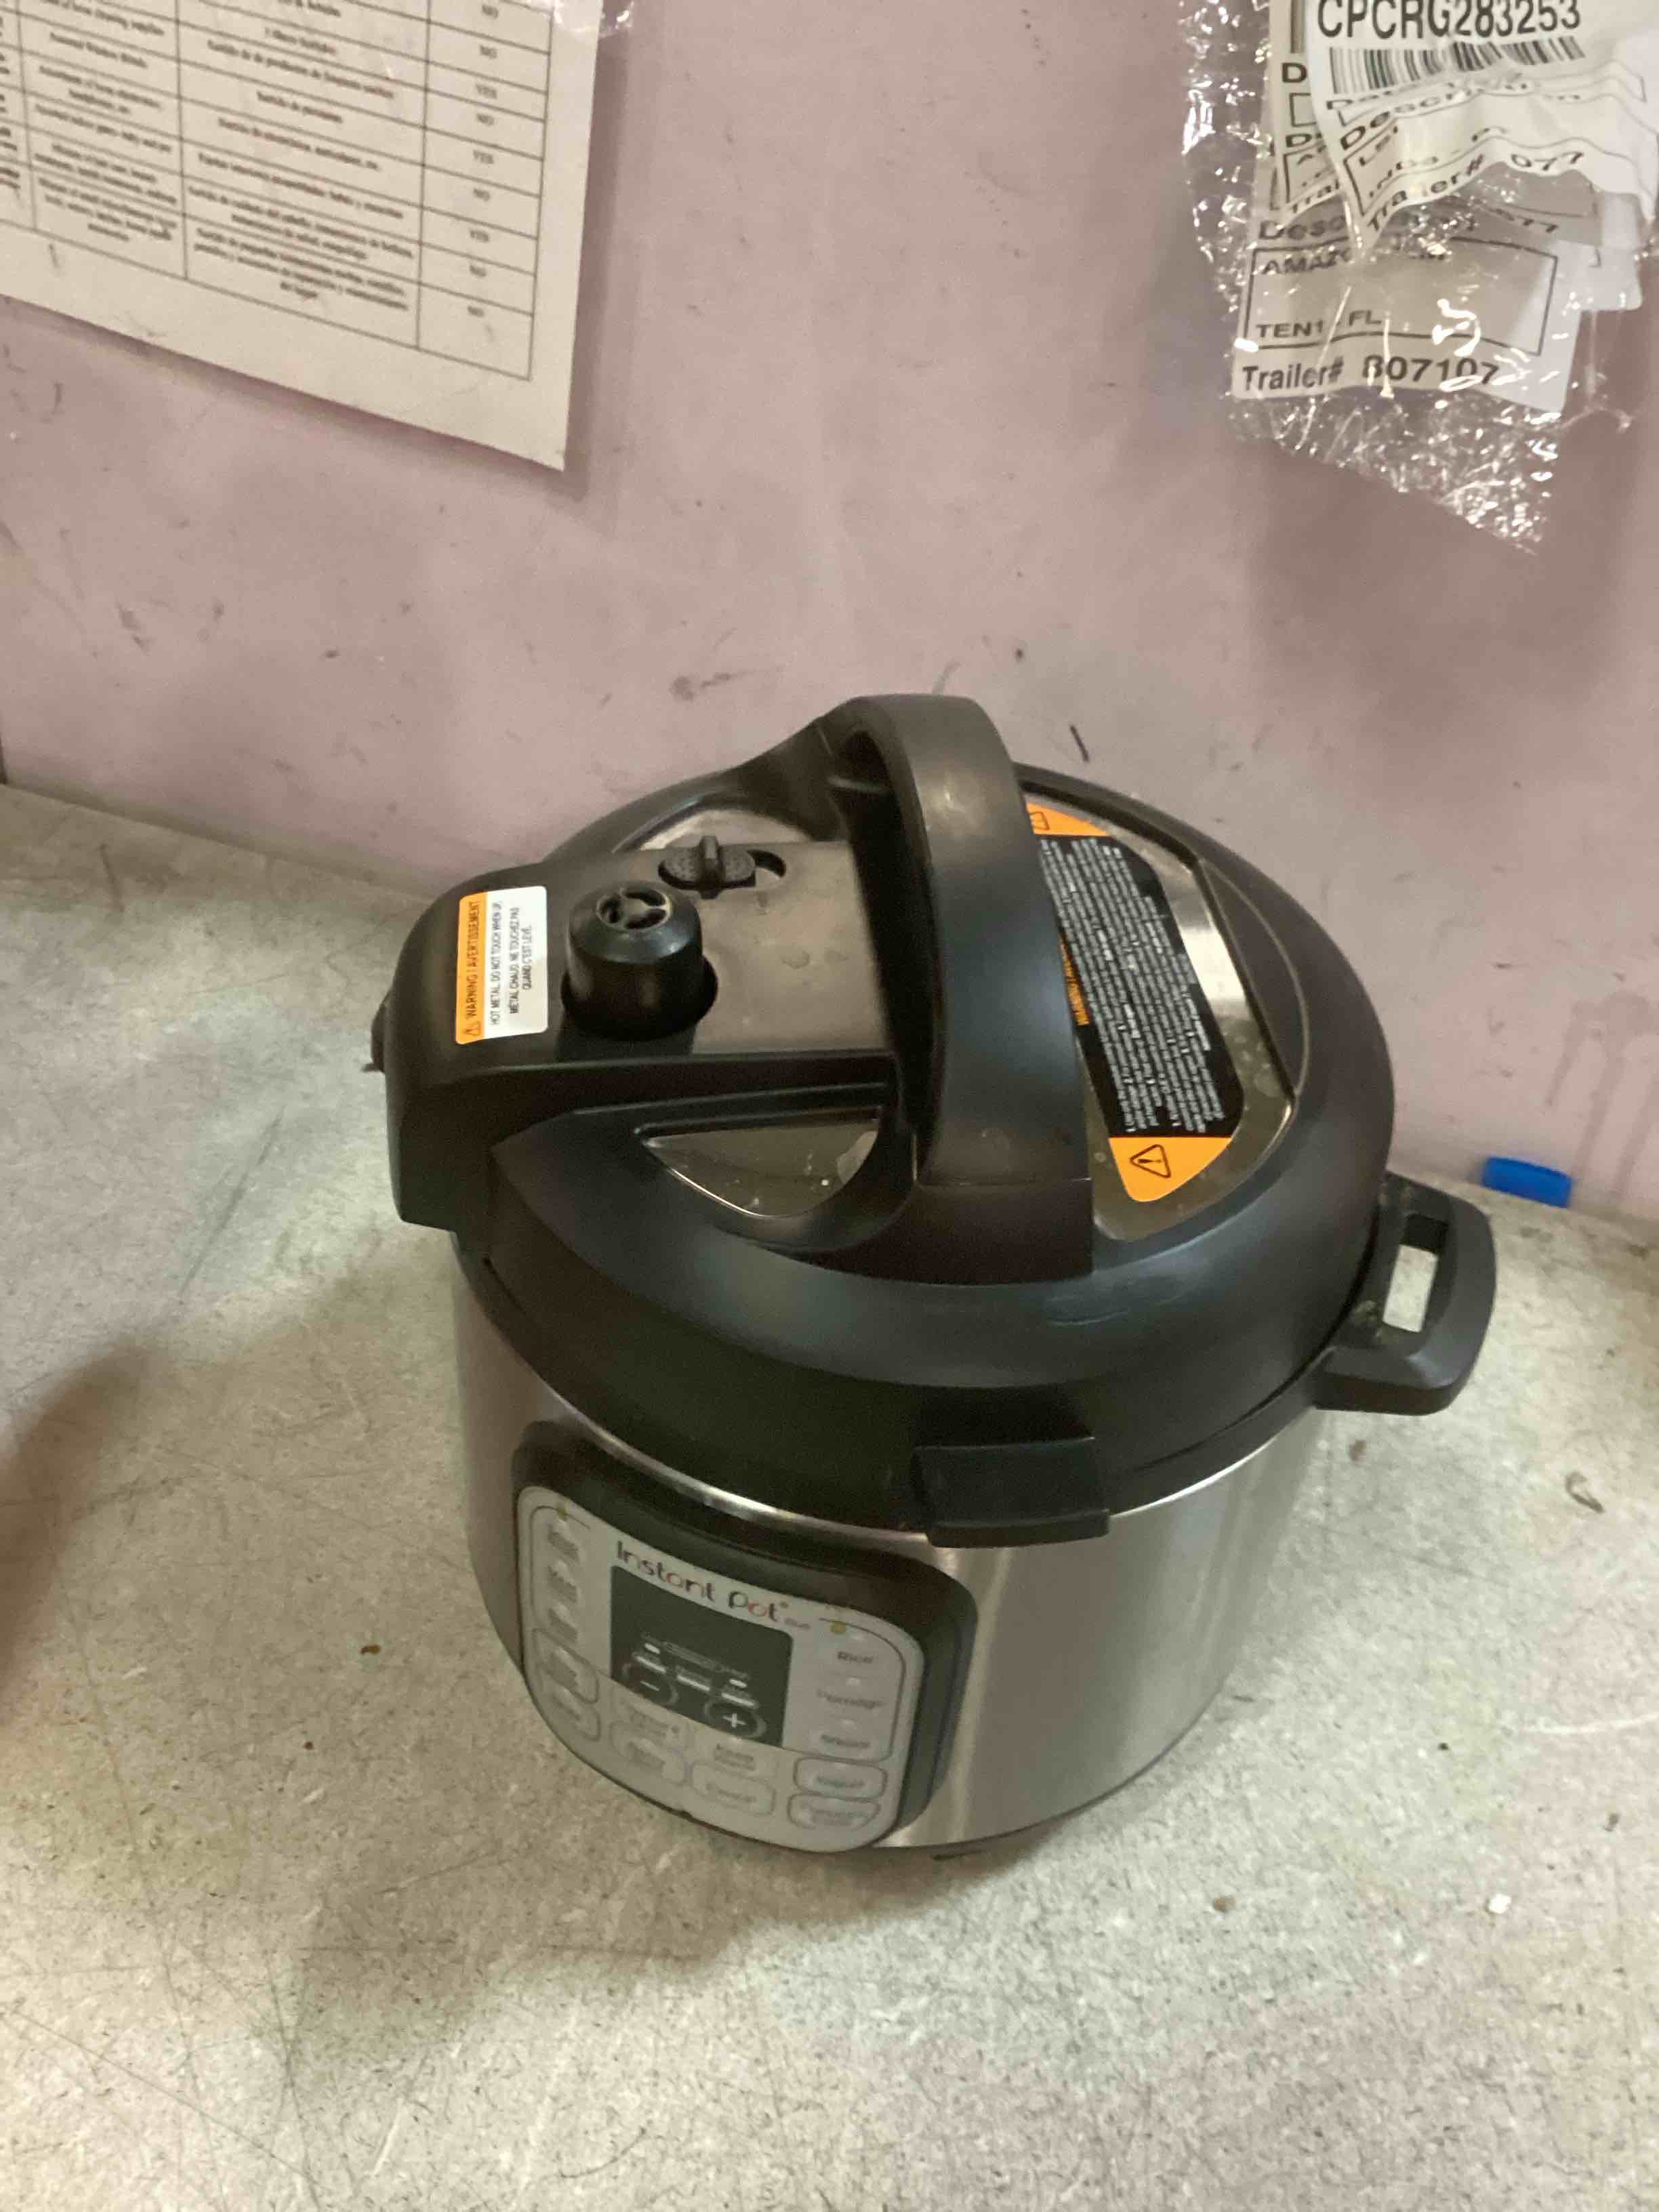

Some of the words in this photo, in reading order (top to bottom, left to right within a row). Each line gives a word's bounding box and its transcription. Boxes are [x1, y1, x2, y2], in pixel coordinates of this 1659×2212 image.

[1242, 356, 1345, 391] Trailer#
[466, 972, 478, 1019] WARNING
[617, 1540, 716, 1603] Instant
